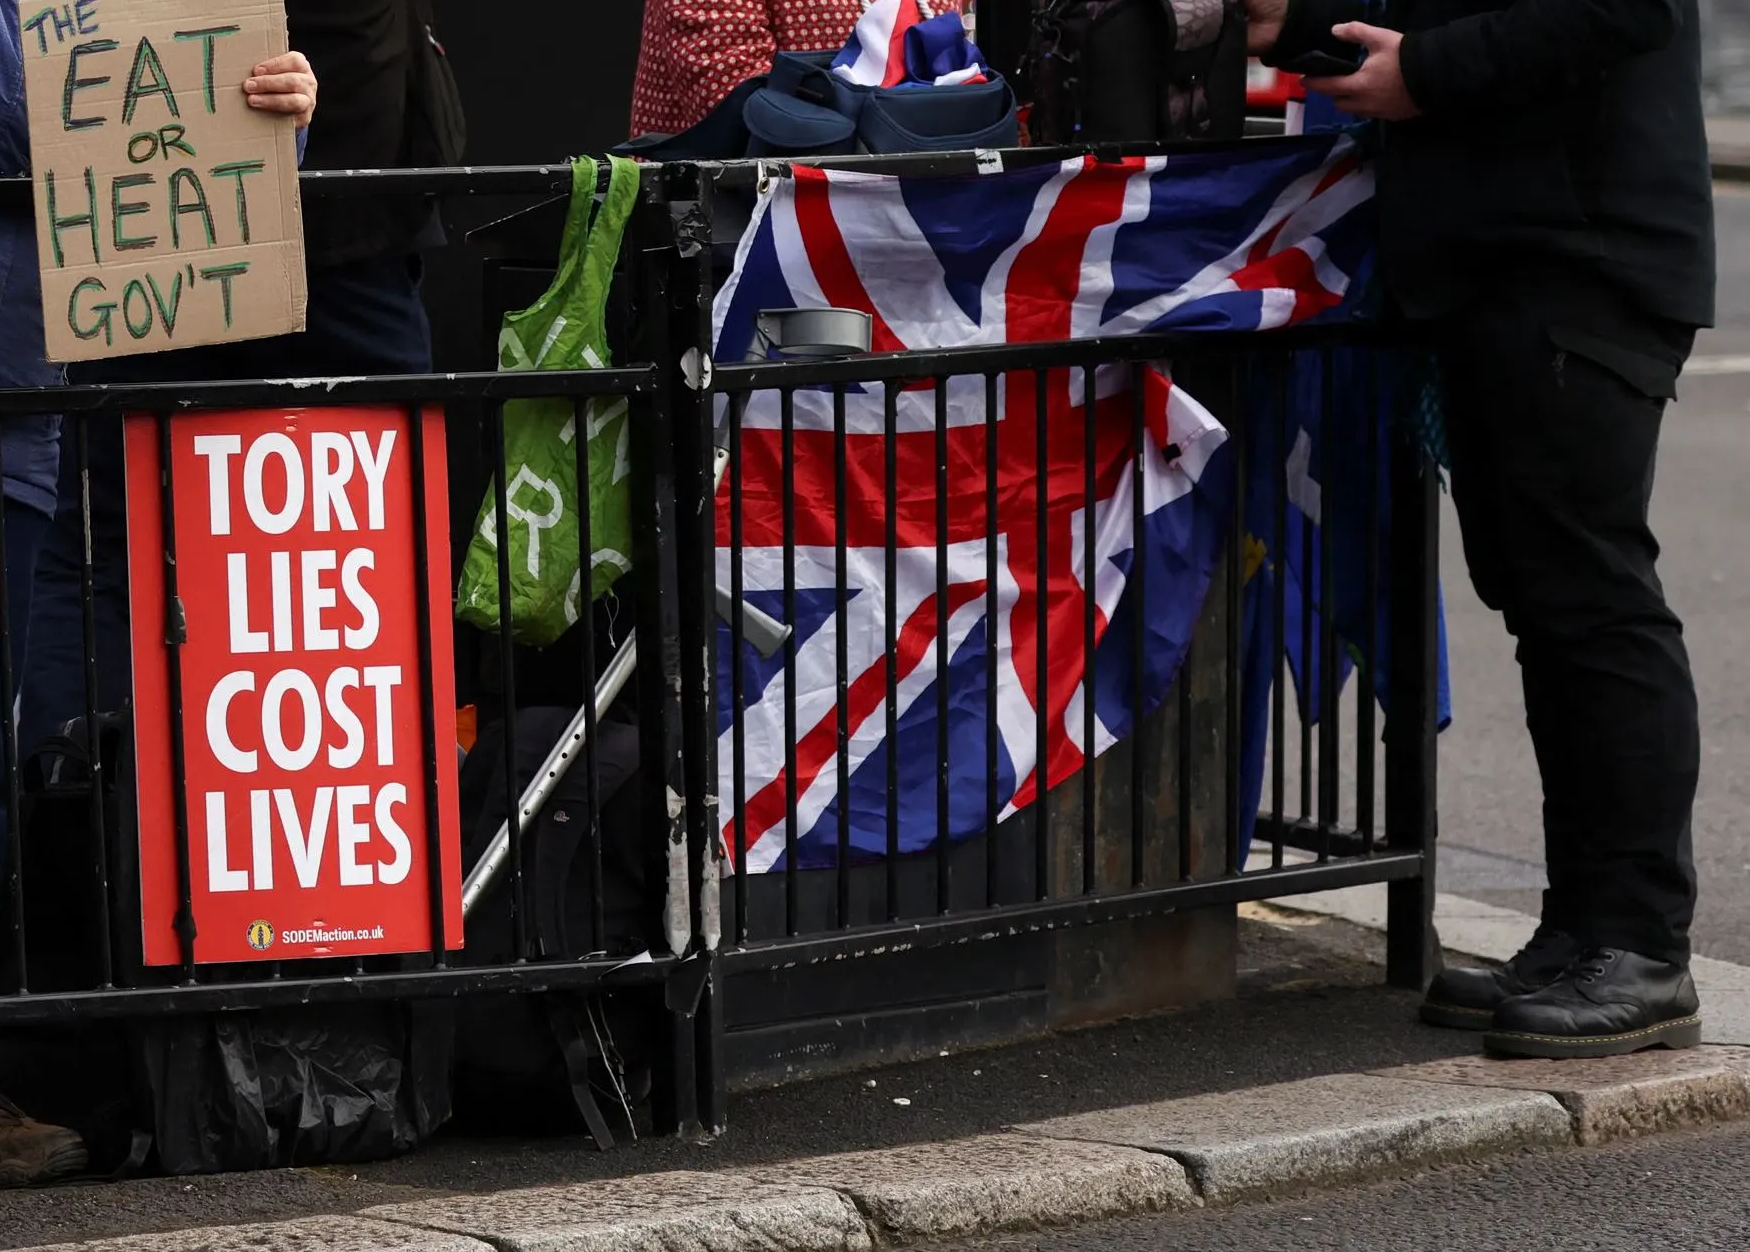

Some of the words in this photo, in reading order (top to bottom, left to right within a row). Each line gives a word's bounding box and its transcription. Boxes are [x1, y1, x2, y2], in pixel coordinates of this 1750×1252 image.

[60, 24, 241, 131] EAT
[127, 123, 196, 164] OR
[44, 158, 266, 268] HEAT
[68, 261, 251, 347] GOV'T
[194, 430, 397, 536] TORY
[227, 548, 380, 653] LIES
[205, 665, 402, 773] COST
[205, 782, 413, 893] LIVES
[281, 924, 385, 944] SODEMaction.co.uk
